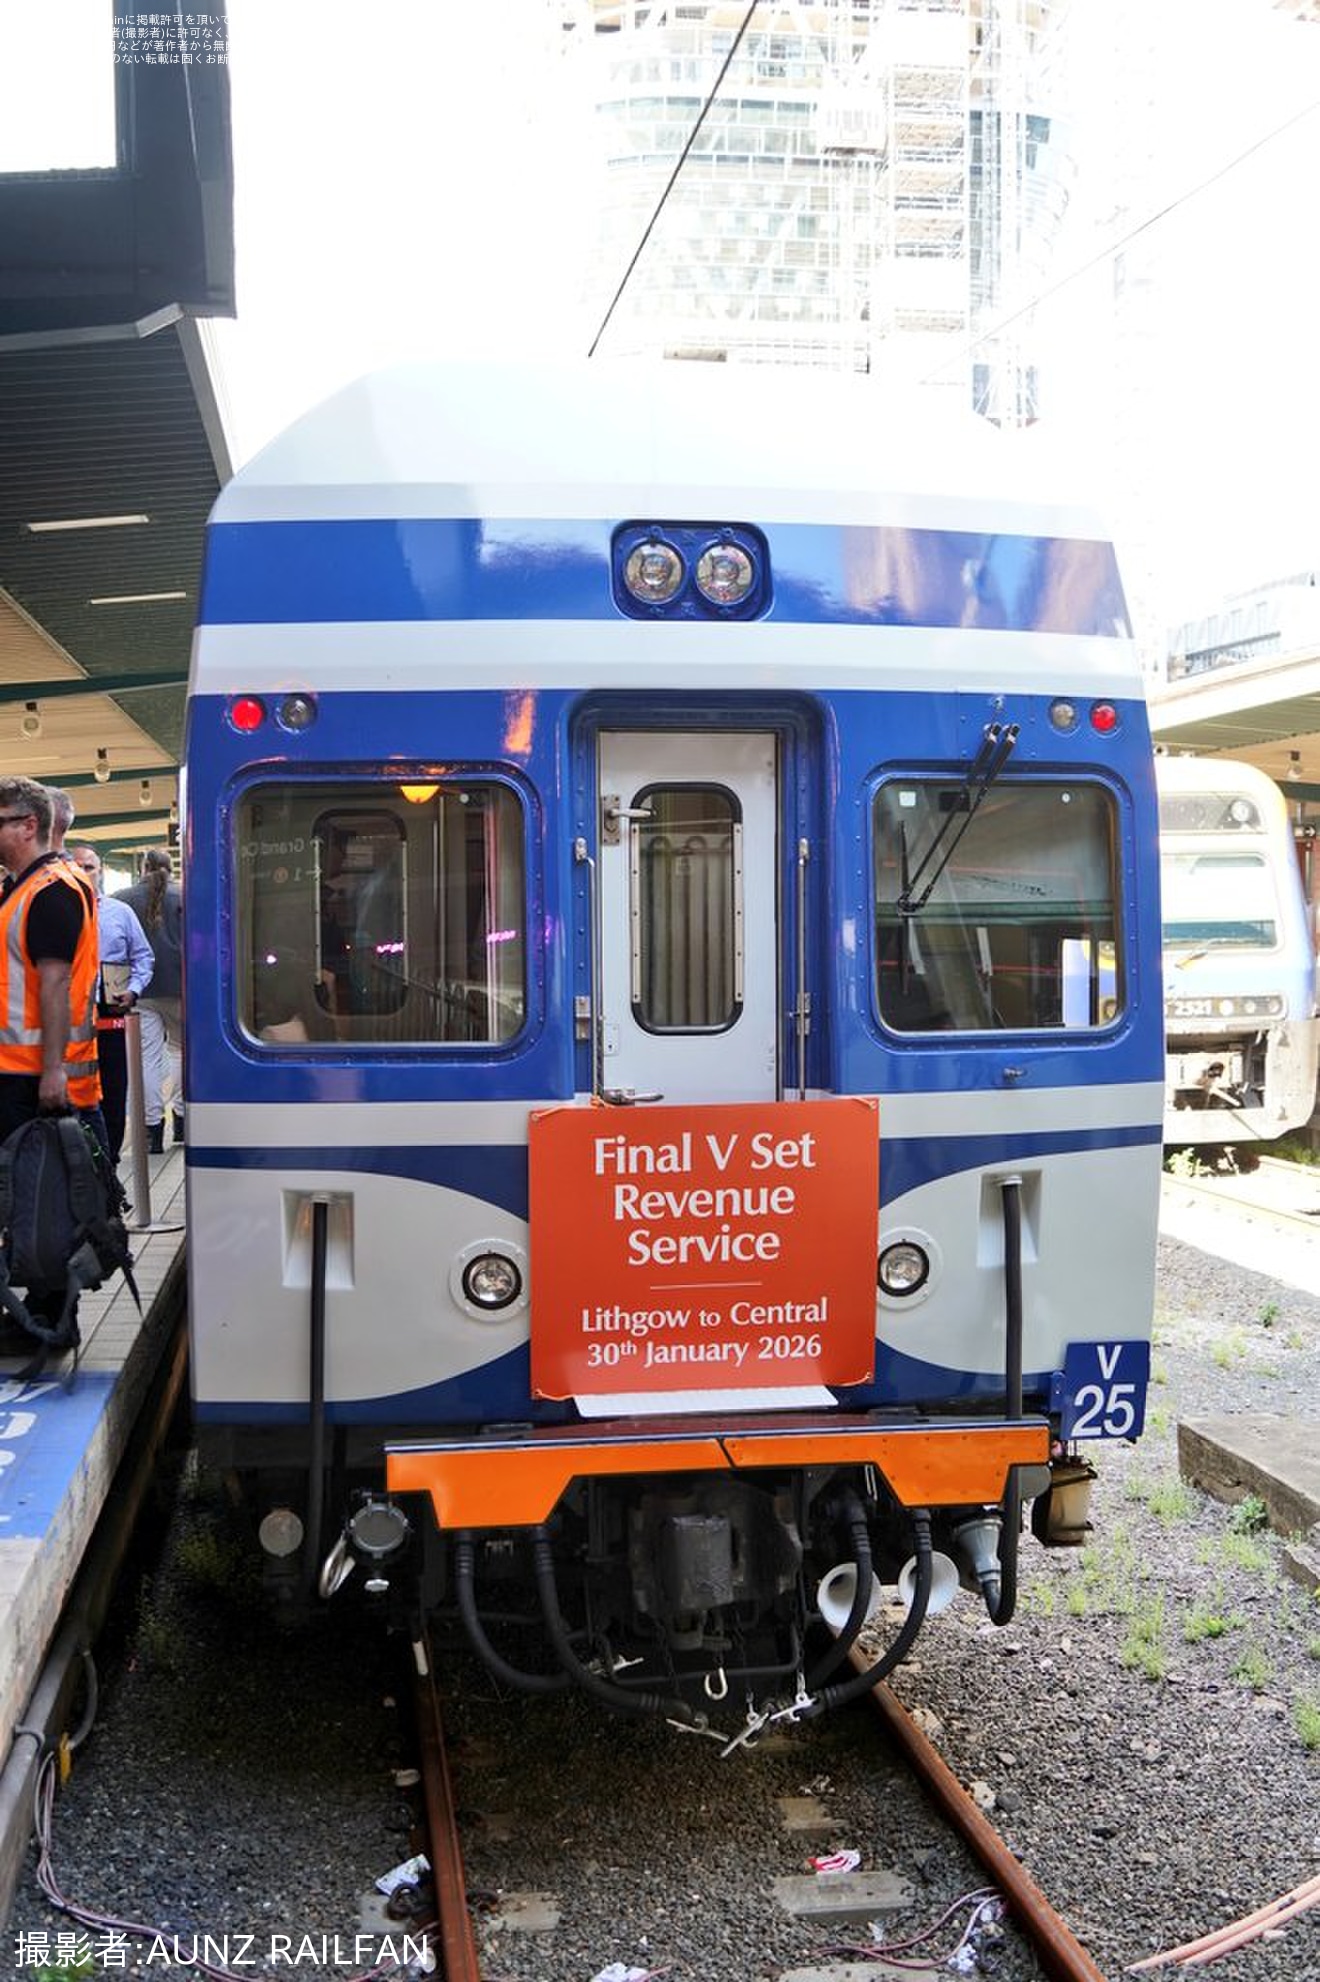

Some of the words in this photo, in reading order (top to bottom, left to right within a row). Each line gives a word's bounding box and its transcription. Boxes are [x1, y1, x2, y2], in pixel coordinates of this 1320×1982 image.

[594, 1132, 692, 1175] Final
[707, 1134, 738, 1171] V
[751, 1133, 816, 1170] Set
[614, 1184, 795, 1221] Revenue
[627, 1224, 781, 1266] Service
[581, 1305, 691, 1337] Lithgow
[699, 1309, 720, 1328] to
[730, 1296, 828, 1325] Central
[587, 1340, 637, 1367] 30th
[644, 1341, 749, 1369] January
[758, 1335, 822, 1361] 2026
[1096, 1344, 1123, 1380] V
[1070, 1384, 1135, 1437] 25
